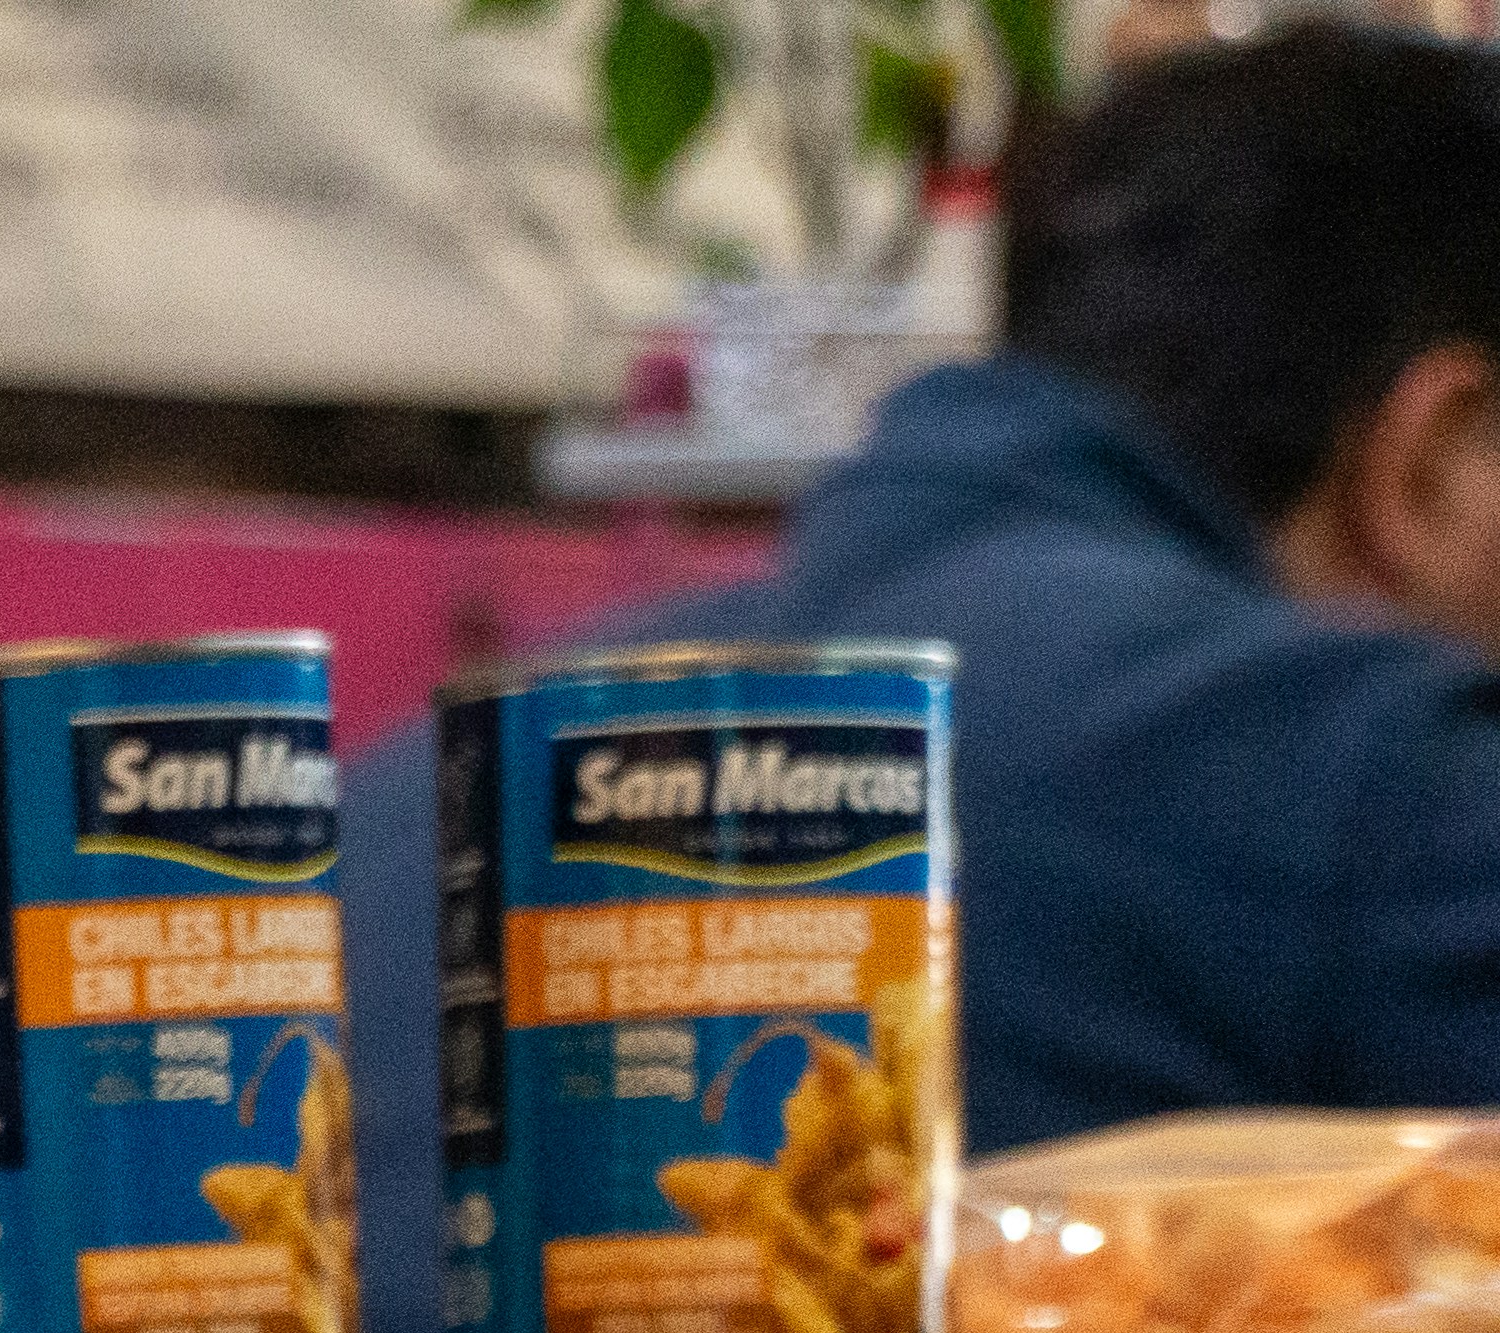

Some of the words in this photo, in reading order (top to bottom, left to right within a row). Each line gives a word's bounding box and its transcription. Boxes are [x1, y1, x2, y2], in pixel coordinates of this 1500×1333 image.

[103, 735, 230, 817] San
[573, 742, 702, 825] San
[710, 735, 924, 815] Marcos
